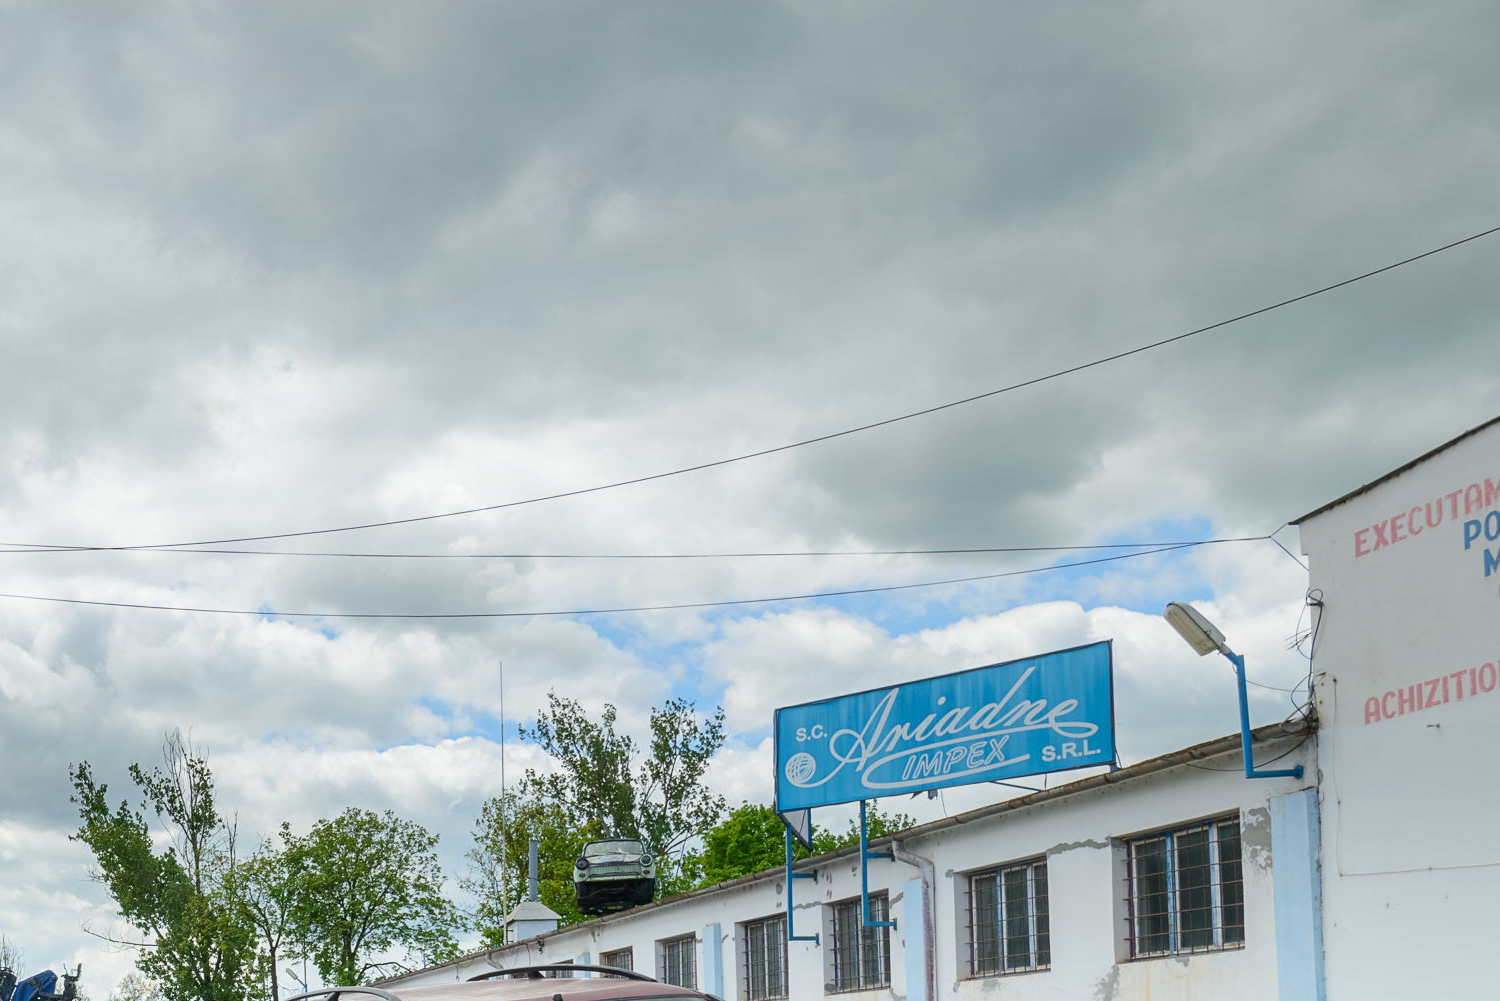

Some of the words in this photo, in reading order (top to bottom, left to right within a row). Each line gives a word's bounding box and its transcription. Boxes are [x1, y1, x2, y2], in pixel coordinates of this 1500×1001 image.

[795, 724, 828, 742] S.C.
[829, 666, 1099, 773] Ariadne
[1364, 660, 1500, 725] ACHIZITIO
[902, 735, 1009, 781] IMPEX
[1041, 740, 1102, 762] S.R.L.
